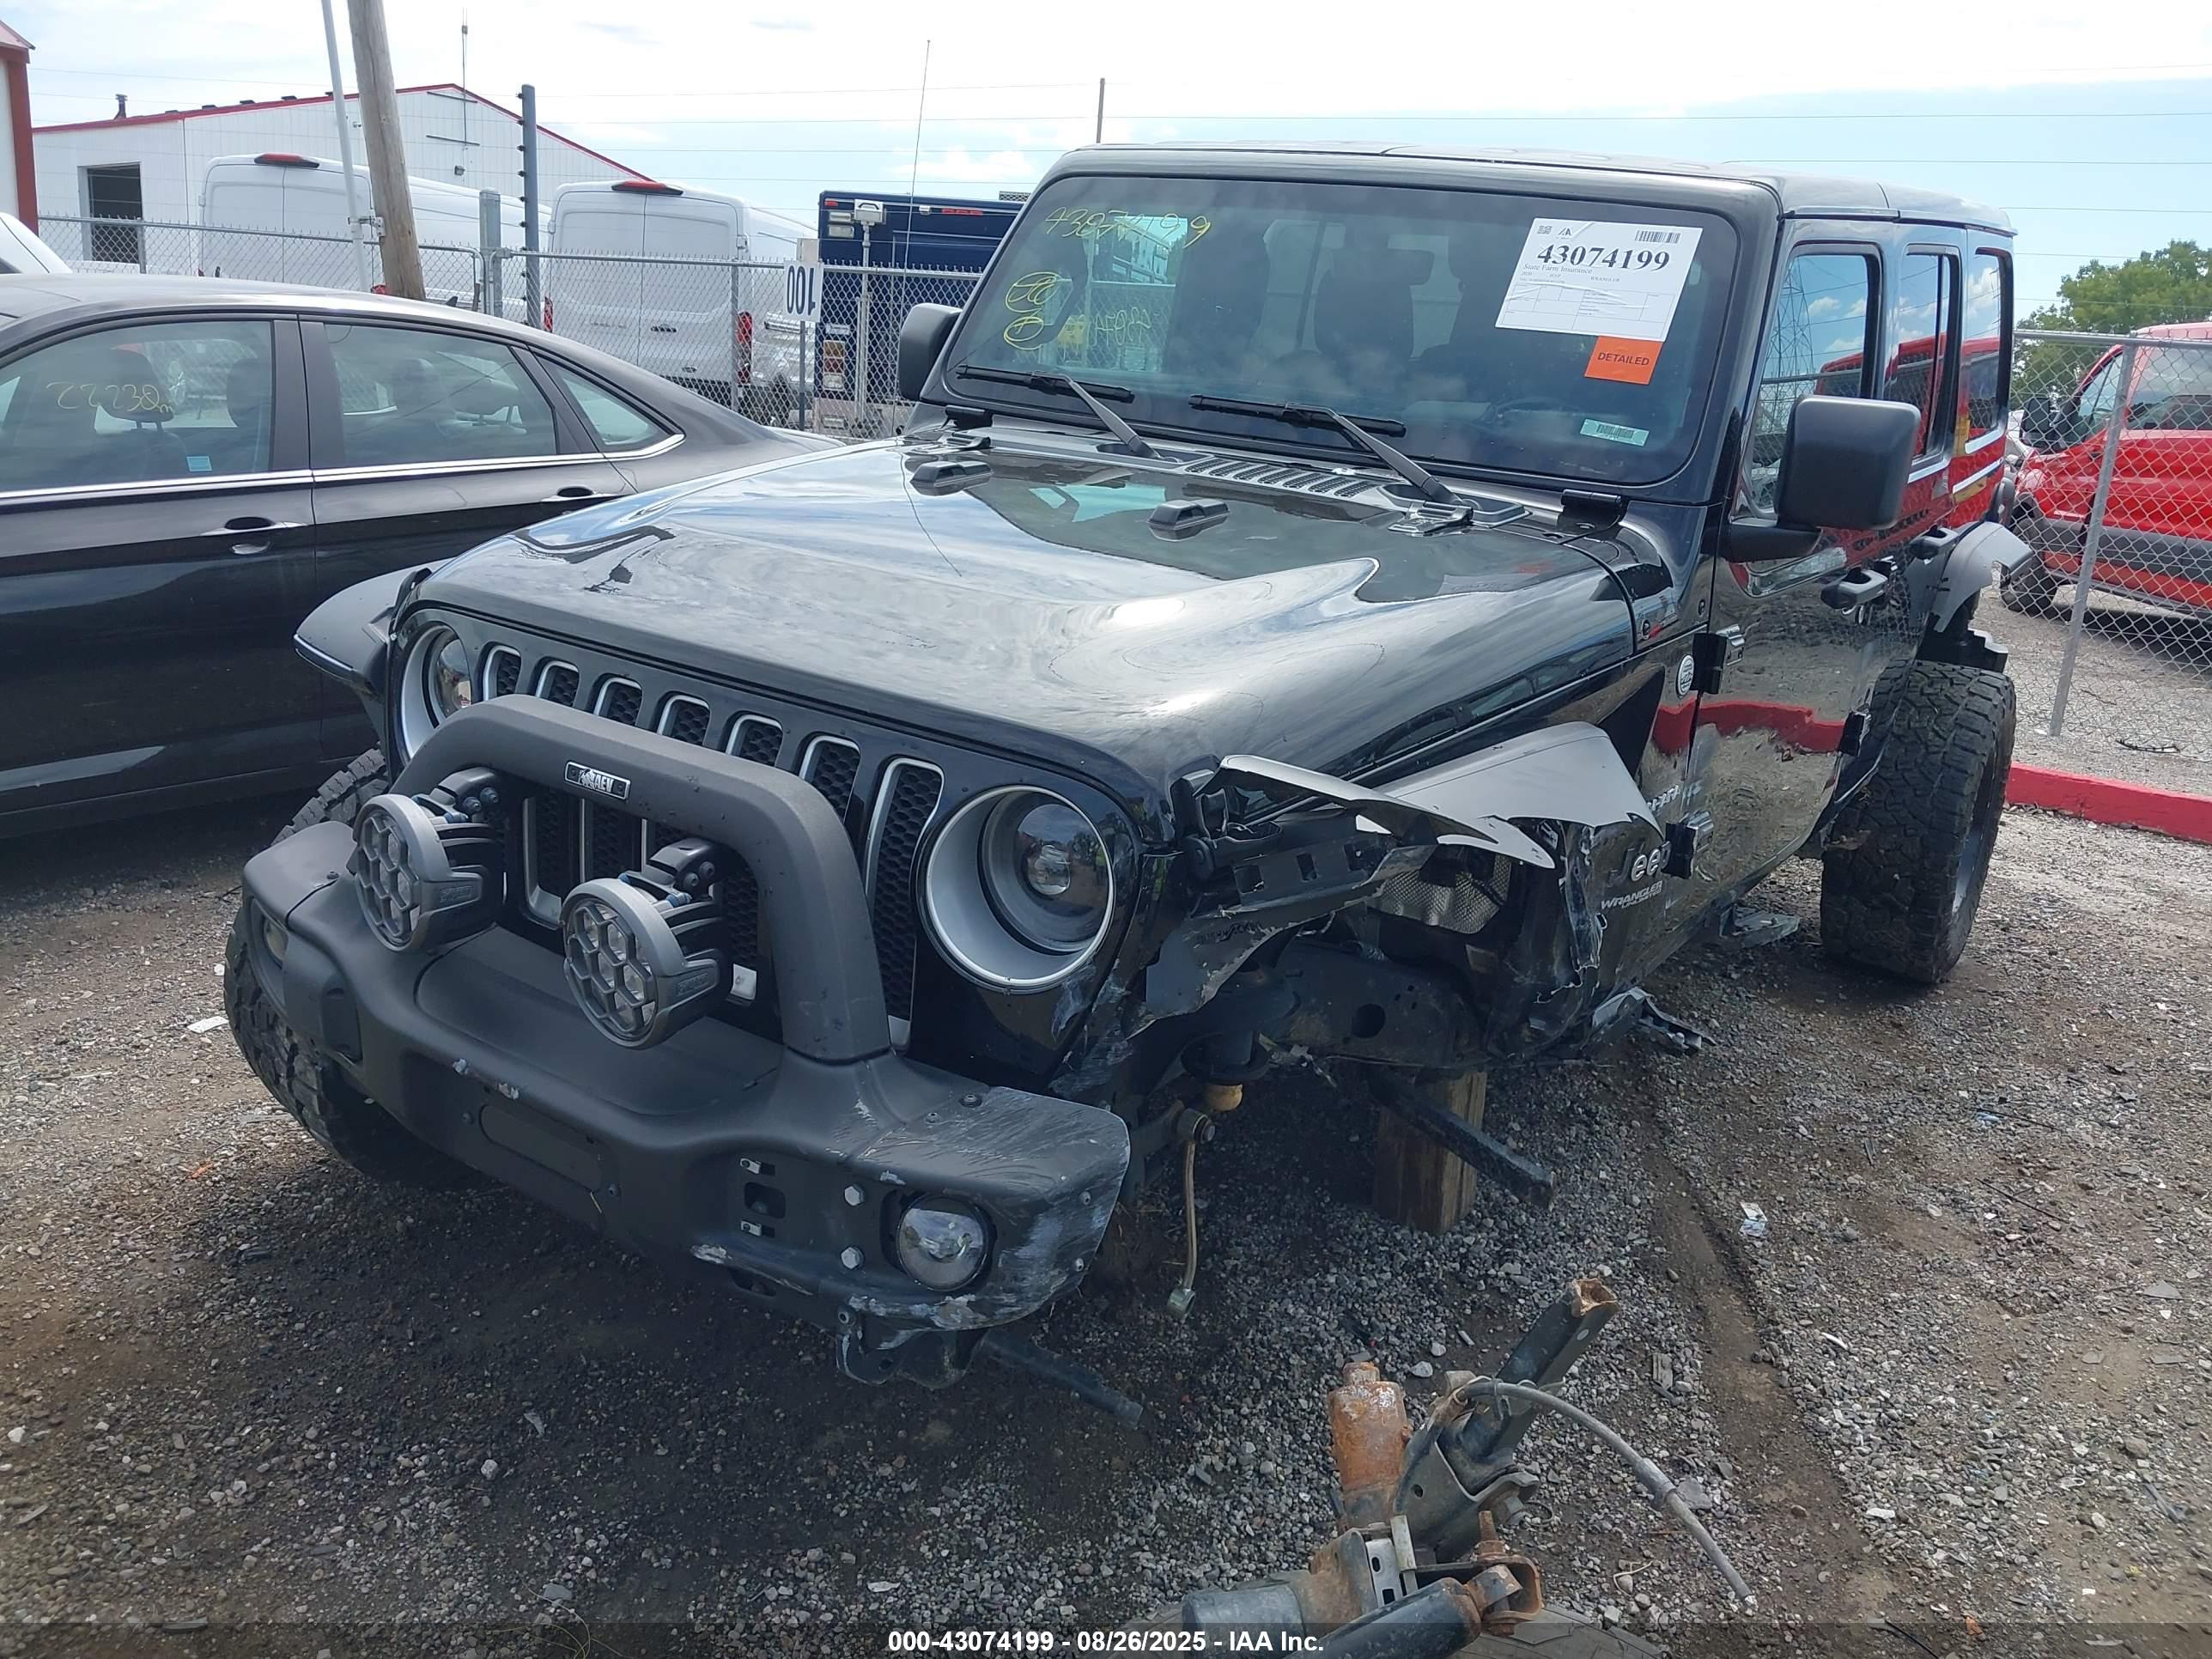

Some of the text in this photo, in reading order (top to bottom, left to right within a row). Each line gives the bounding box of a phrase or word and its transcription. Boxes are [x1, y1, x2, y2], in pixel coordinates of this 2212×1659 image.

[1537, 244, 1670, 271] 43074199
[1560, 266, 1593, 275] Insurance
[1597, 351, 1650, 367] DETAILED
[594, 774, 615, 793] AEV
[1601, 880, 1663, 909] WRANGLER
